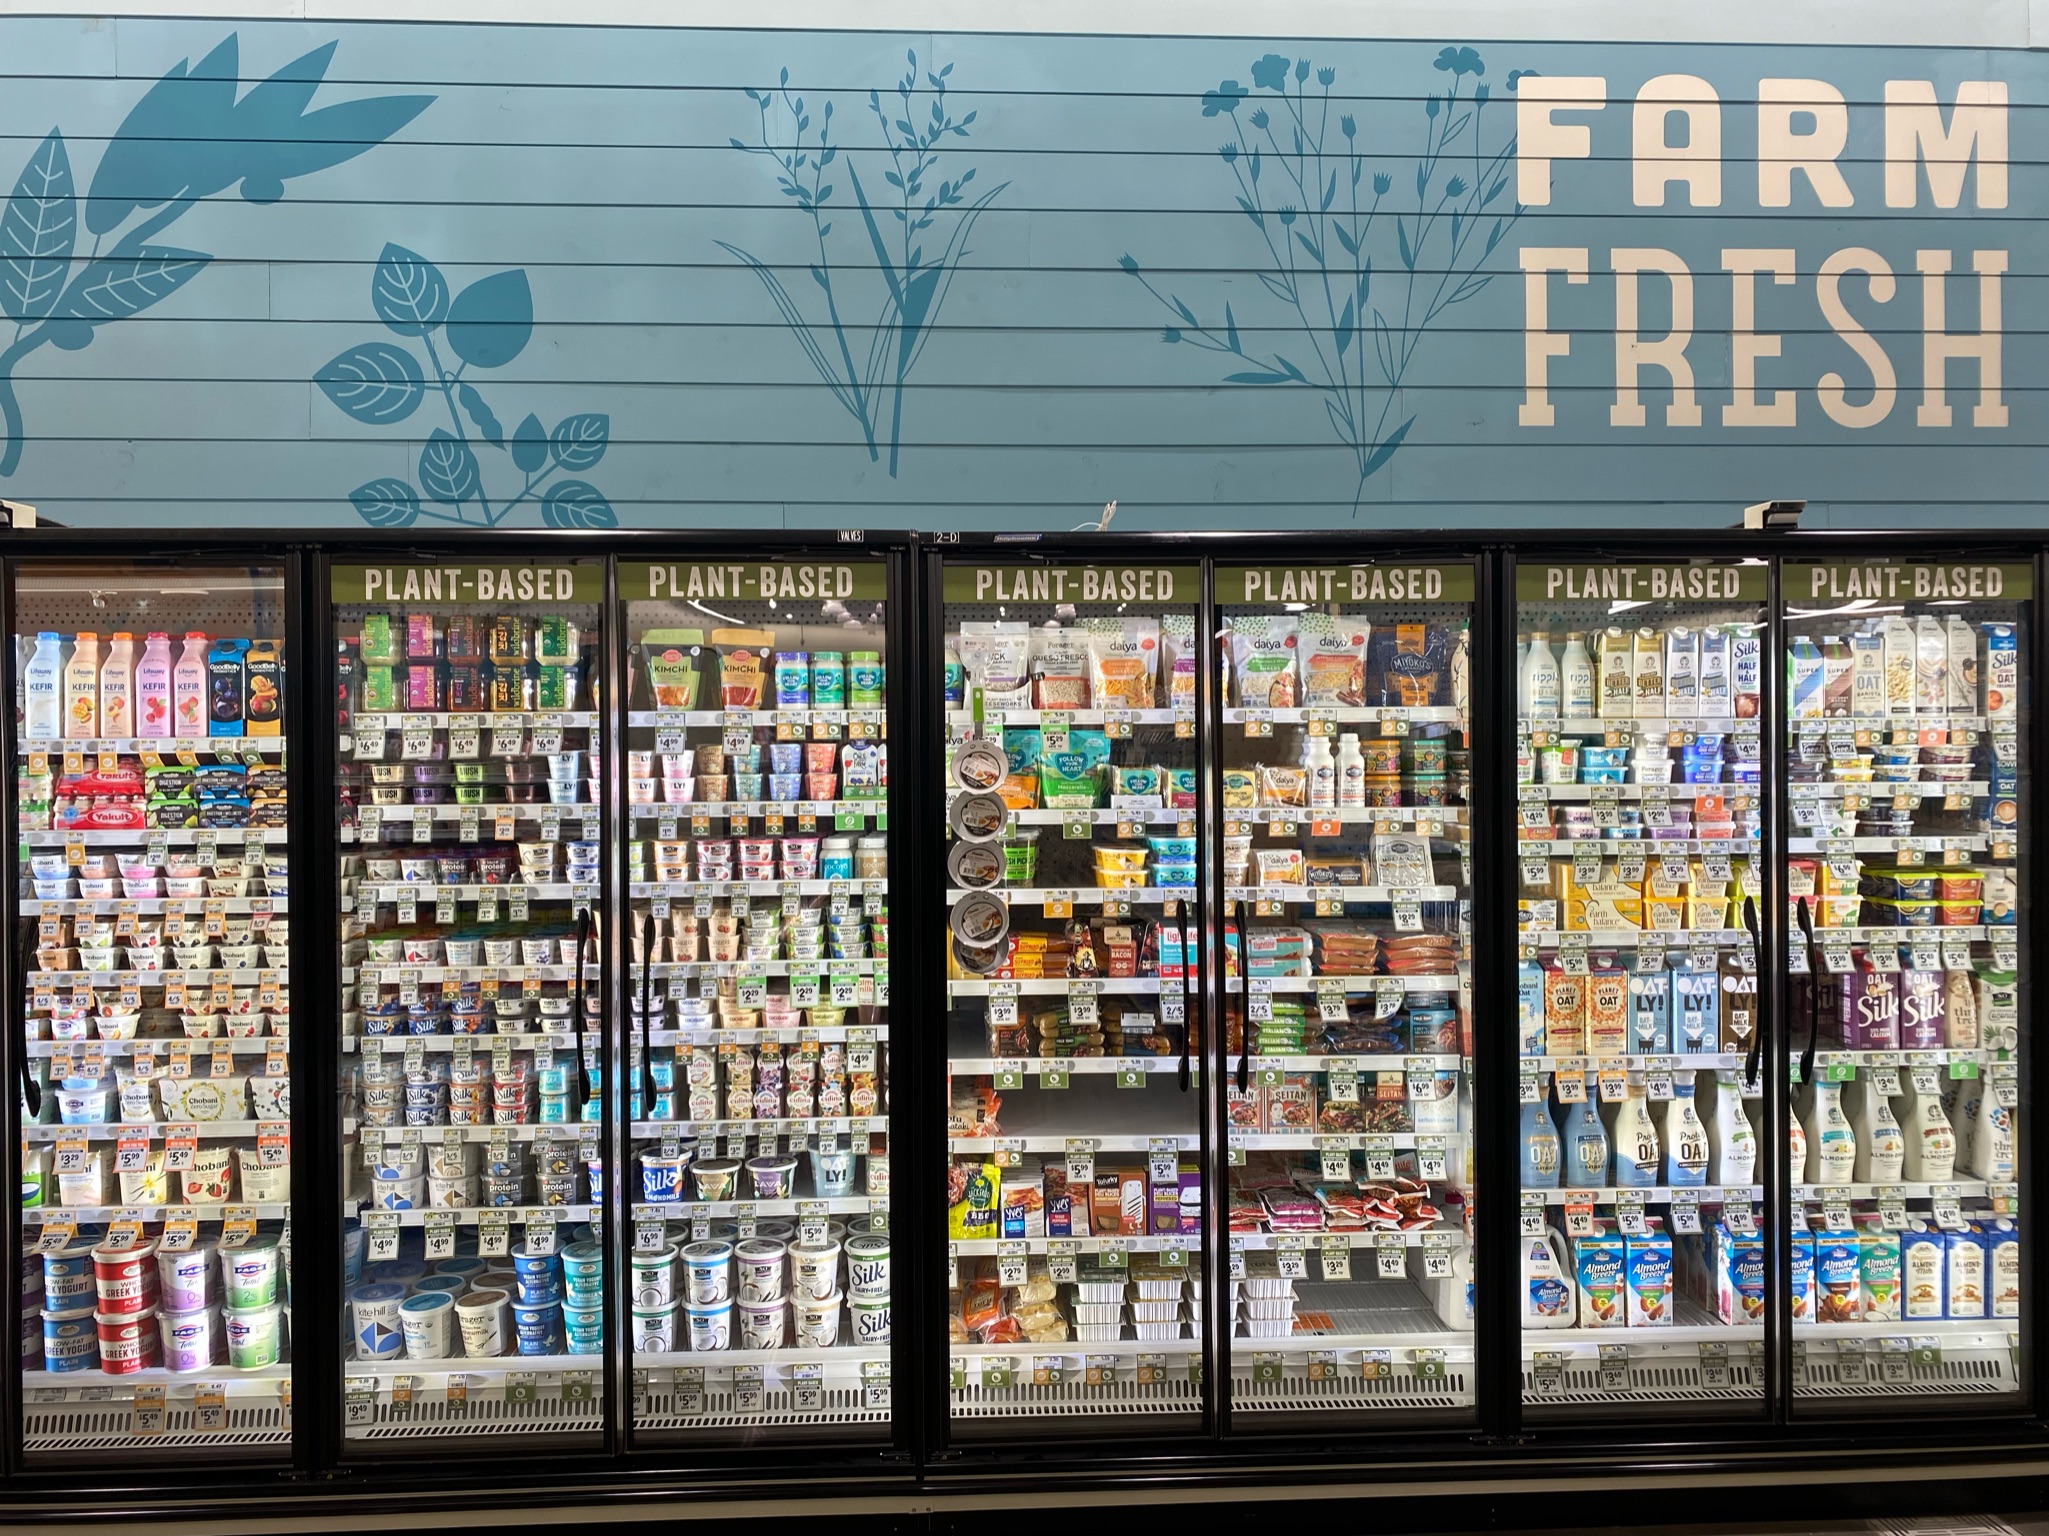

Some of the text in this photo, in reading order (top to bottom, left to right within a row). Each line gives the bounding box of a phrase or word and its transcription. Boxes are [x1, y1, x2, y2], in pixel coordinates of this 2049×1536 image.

[1517, 74, 2008, 209] FARM
[1518, 247, 2008, 428] FRESH
[841, 531, 861, 540] VALVES
[937, 532, 957, 542] 2-D
[365, 569, 574, 600] PLANT-BASED
[650, 566, 852, 597] PLANT-BASED
[976, 570, 1173, 600] PLANT-BASED
[1245, 569, 1442, 601] PLANT-BASED
[1547, 568, 1739, 598] PLANT-BASED
[1811, 567, 2003, 598] PLANT-BASED
[1110, 642, 1137, 652] daiya
[1254, 639, 1281, 650] daiya
[1319, 637, 1346, 648] daiya
[1735, 641, 1758, 658] Silk
[1394, 657, 1432, 670] MIYOKO'S
[1992, 652, 2016, 669] Silk
[655, 665, 688, 674] KIMCHI
[724, 665, 756, 674] KIMCHI
[1738, 662, 1756, 671] HALF
[1606, 677, 1630, 687] BETTER
[1637, 677, 1662, 687] BETTER
[1738, 674, 1756, 682] HALF
[1857, 675, 1881, 690] OAT
[1998, 675, 2015, 684] OAT
[30, 682, 53, 691] KEFIR
[72, 683, 96, 691] KEFIR
[104, 683, 125, 691] KEFIR
[142, 682, 166, 691] KEFIR
[178, 682, 199, 691] KEFIR
[1613, 688, 1631, 696] HALF
[1645, 688, 1663, 696] HALF
[1679, 688, 1695, 696] HALF
[1711, 688, 1727, 696] HALF
[1059, 755, 1084, 764] FOLLOW
[460, 767, 478, 776] MUSH
[1062, 764, 1082, 772] HEART
[1276, 776, 1294, 784] daiya
[378, 789, 398, 799] MUSH
[460, 789, 480, 798] MUSH
[95, 811, 132, 821] Yakult
[1271, 857, 1289, 865] daiya
[1592, 882, 1619, 891] balance
[1655, 882, 1677, 890] balance
[1699, 882, 1721, 890] balance
[1589, 910, 1607, 918] earth
[1594, 917, 1619, 925] balance
[1656, 916, 1678, 924] balance
[1698, 916, 1720, 924] balance
[1868, 974, 1887, 984] OAT
[1914, 974, 1933, 984] OAT
[1629, 977, 1668, 993] OAT-
[1599, 987, 1618, 995] PLANET
[1557, 996, 1575, 1005] OAT
[1600, 996, 1618, 1006] OAT
[1637, 994, 1664, 1011] LY!
[1684, 994, 1711, 1011] LY!
[1858, 993, 1899, 1027] Silk
[1904, 993, 1944, 1027] Silk
[123, 1094, 153, 1102] Chobani
[1276, 1091, 1306, 1100] SEITAN
[189, 1097, 218, 1105] Chobani
[1530, 1146, 1556, 1163] OAT
[1579, 1145, 1605, 1162] OAT
[1639, 1144, 1660, 1160] OAT
[1682, 1144, 1707, 1160] OAT
[826, 1169, 846, 1182] LY!
[489, 1182, 519, 1193] protein
[542, 1182, 572, 1192] protein
[643, 1170, 672, 1195] Silk
[1584, 1260, 1621, 1274] Almond
[1633, 1260, 1669, 1273] Almond
[1822, 1257, 1857, 1270] Almond
[1863, 1257, 1899, 1269] Almond
[237, 1264, 264, 1274] FAGE
[1829, 1266, 1852, 1276] Breeze
[1870, 1265, 1894, 1275] Breeze
[852, 1262, 886, 1287] Silk
[1591, 1270, 1616, 1280] Breeze
[1640, 1269, 1664, 1280] Breeze
[1538, 1287, 1562, 1297] Almond
[124, 1297, 143, 1306] PLAIN
[358, 1307, 386, 1317] kite hill
[858, 1310, 890, 1336] Silk
[175, 1326, 201, 1336] FAGE
[53, 1338, 84, 1347] LOW-FAT
[66, 1341, 96, 1354] YOGURT
[106, 1349, 129, 1359] GREEK
[123, 1359, 141, 1367] PLAIN
